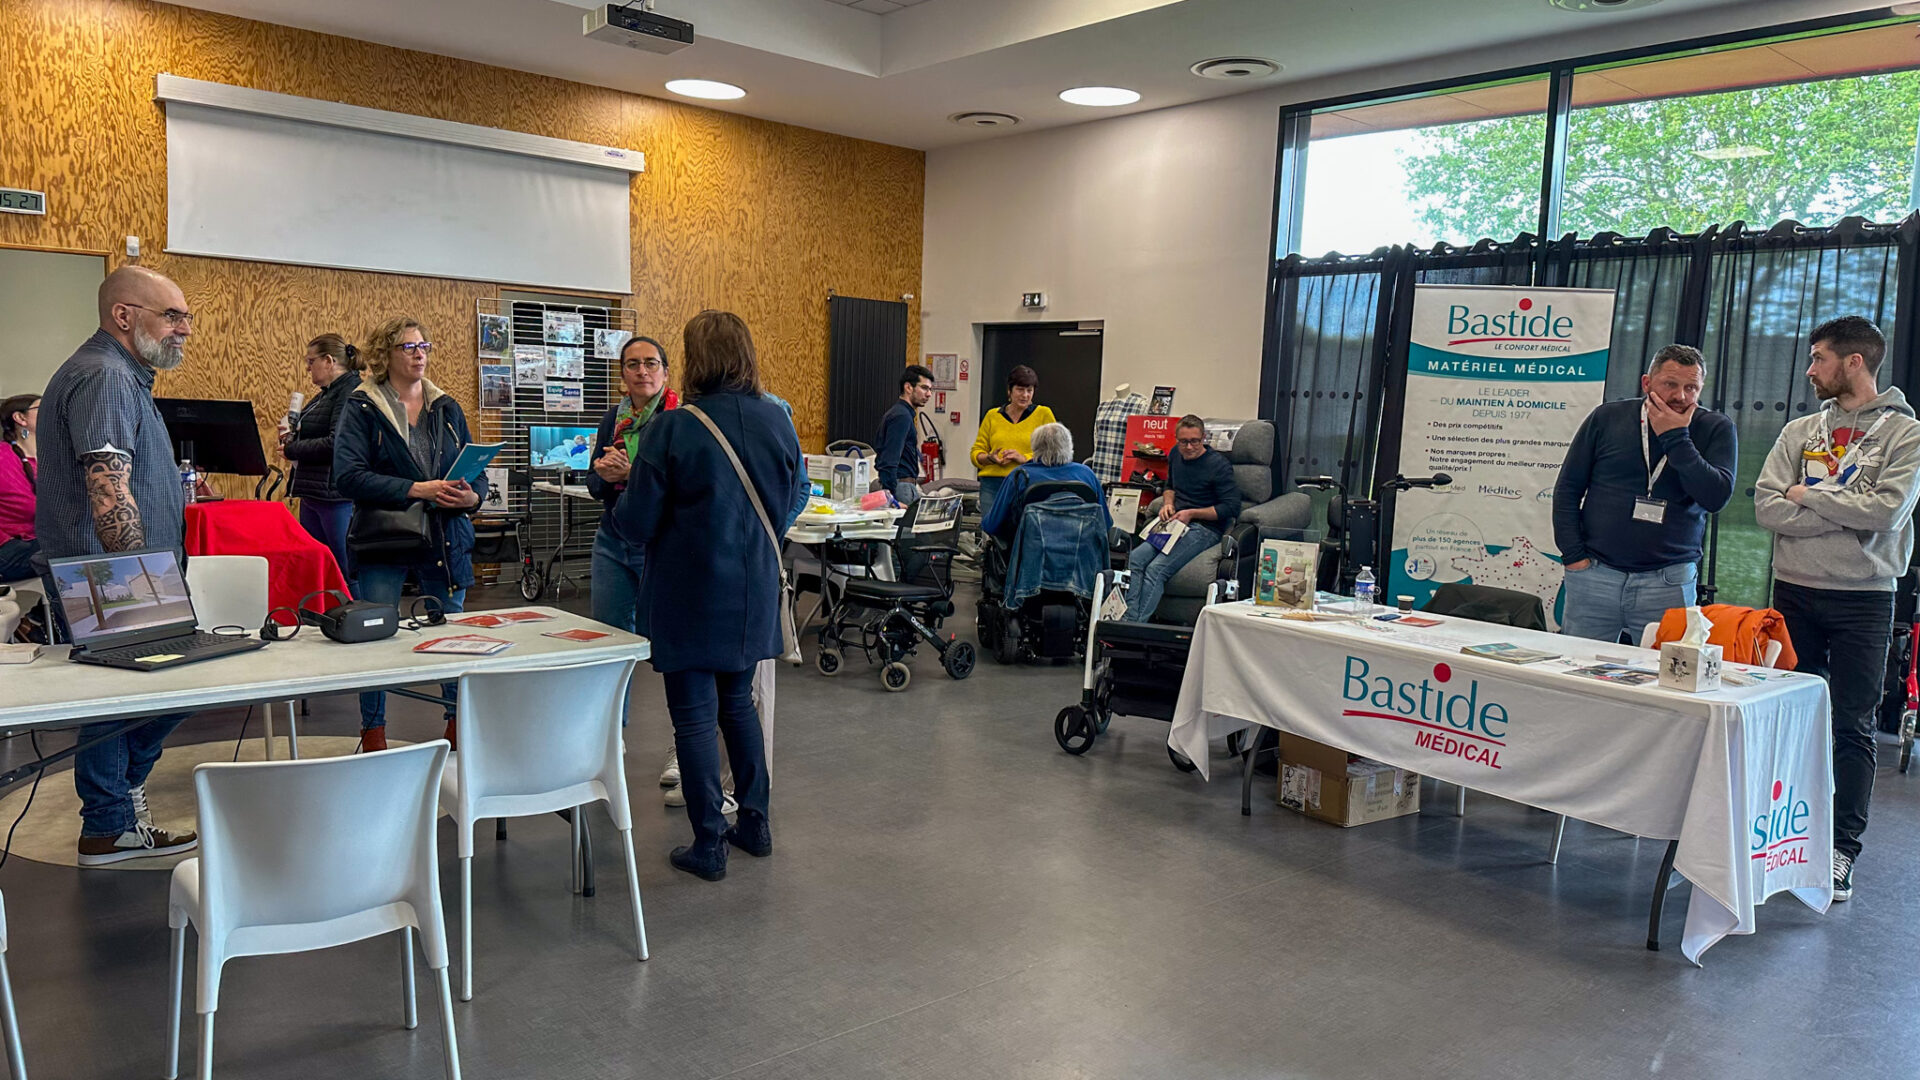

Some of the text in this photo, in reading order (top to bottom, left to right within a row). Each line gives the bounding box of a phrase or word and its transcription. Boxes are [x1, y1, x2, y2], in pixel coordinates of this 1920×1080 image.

[20, 194, 39, 209] 27
[1448, 298, 1573, 338] Bastide
[1504, 343, 1539, 351] CONFORT
[1428, 360, 1586, 376] MATÉRIEL MÉDICAL
[1478, 387, 1530, 398] LE LEADER
[1440, 397, 1567, 410] DU MAINTIEN À DOMICILE
[1472, 409, 1531, 420] DEPUIS 1977
[1143, 418, 1169, 430] neut
[1447, 435, 1479, 443] sélection
[1429, 464, 1468, 472] qualité/prix
[1478, 484, 1522, 496] Méditec
[1453, 538, 1480, 546] agences
[1343, 655, 1509, 738] Bastide
[1415, 730, 1502, 770] MÉDICAL
[1751, 780, 1810, 850] side
[1766, 846, 1808, 872] ÉDICAL
